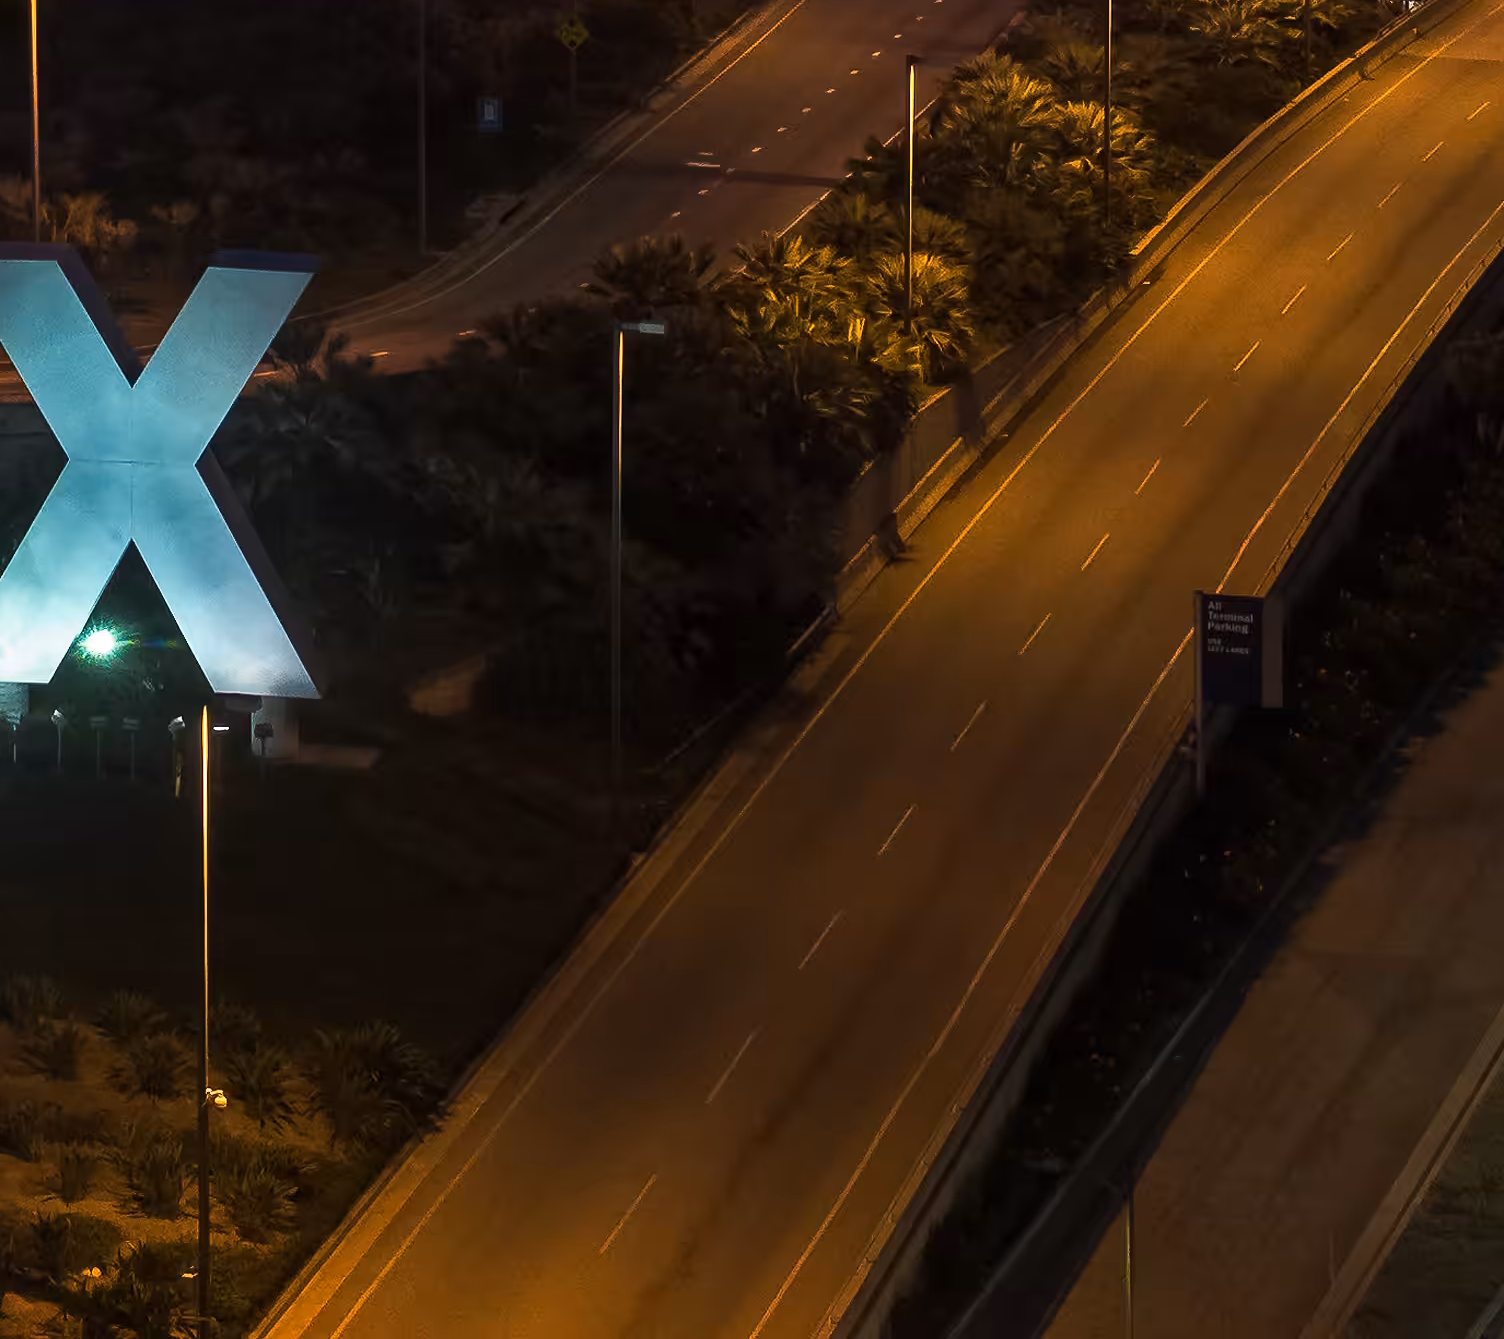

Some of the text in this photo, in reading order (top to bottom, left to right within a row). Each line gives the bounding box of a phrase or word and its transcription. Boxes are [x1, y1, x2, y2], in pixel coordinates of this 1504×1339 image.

[1208, 601, 1222, 611] All
[1208, 610, 1253, 622] Terminal
[1208, 622, 1249, 634] Parking
